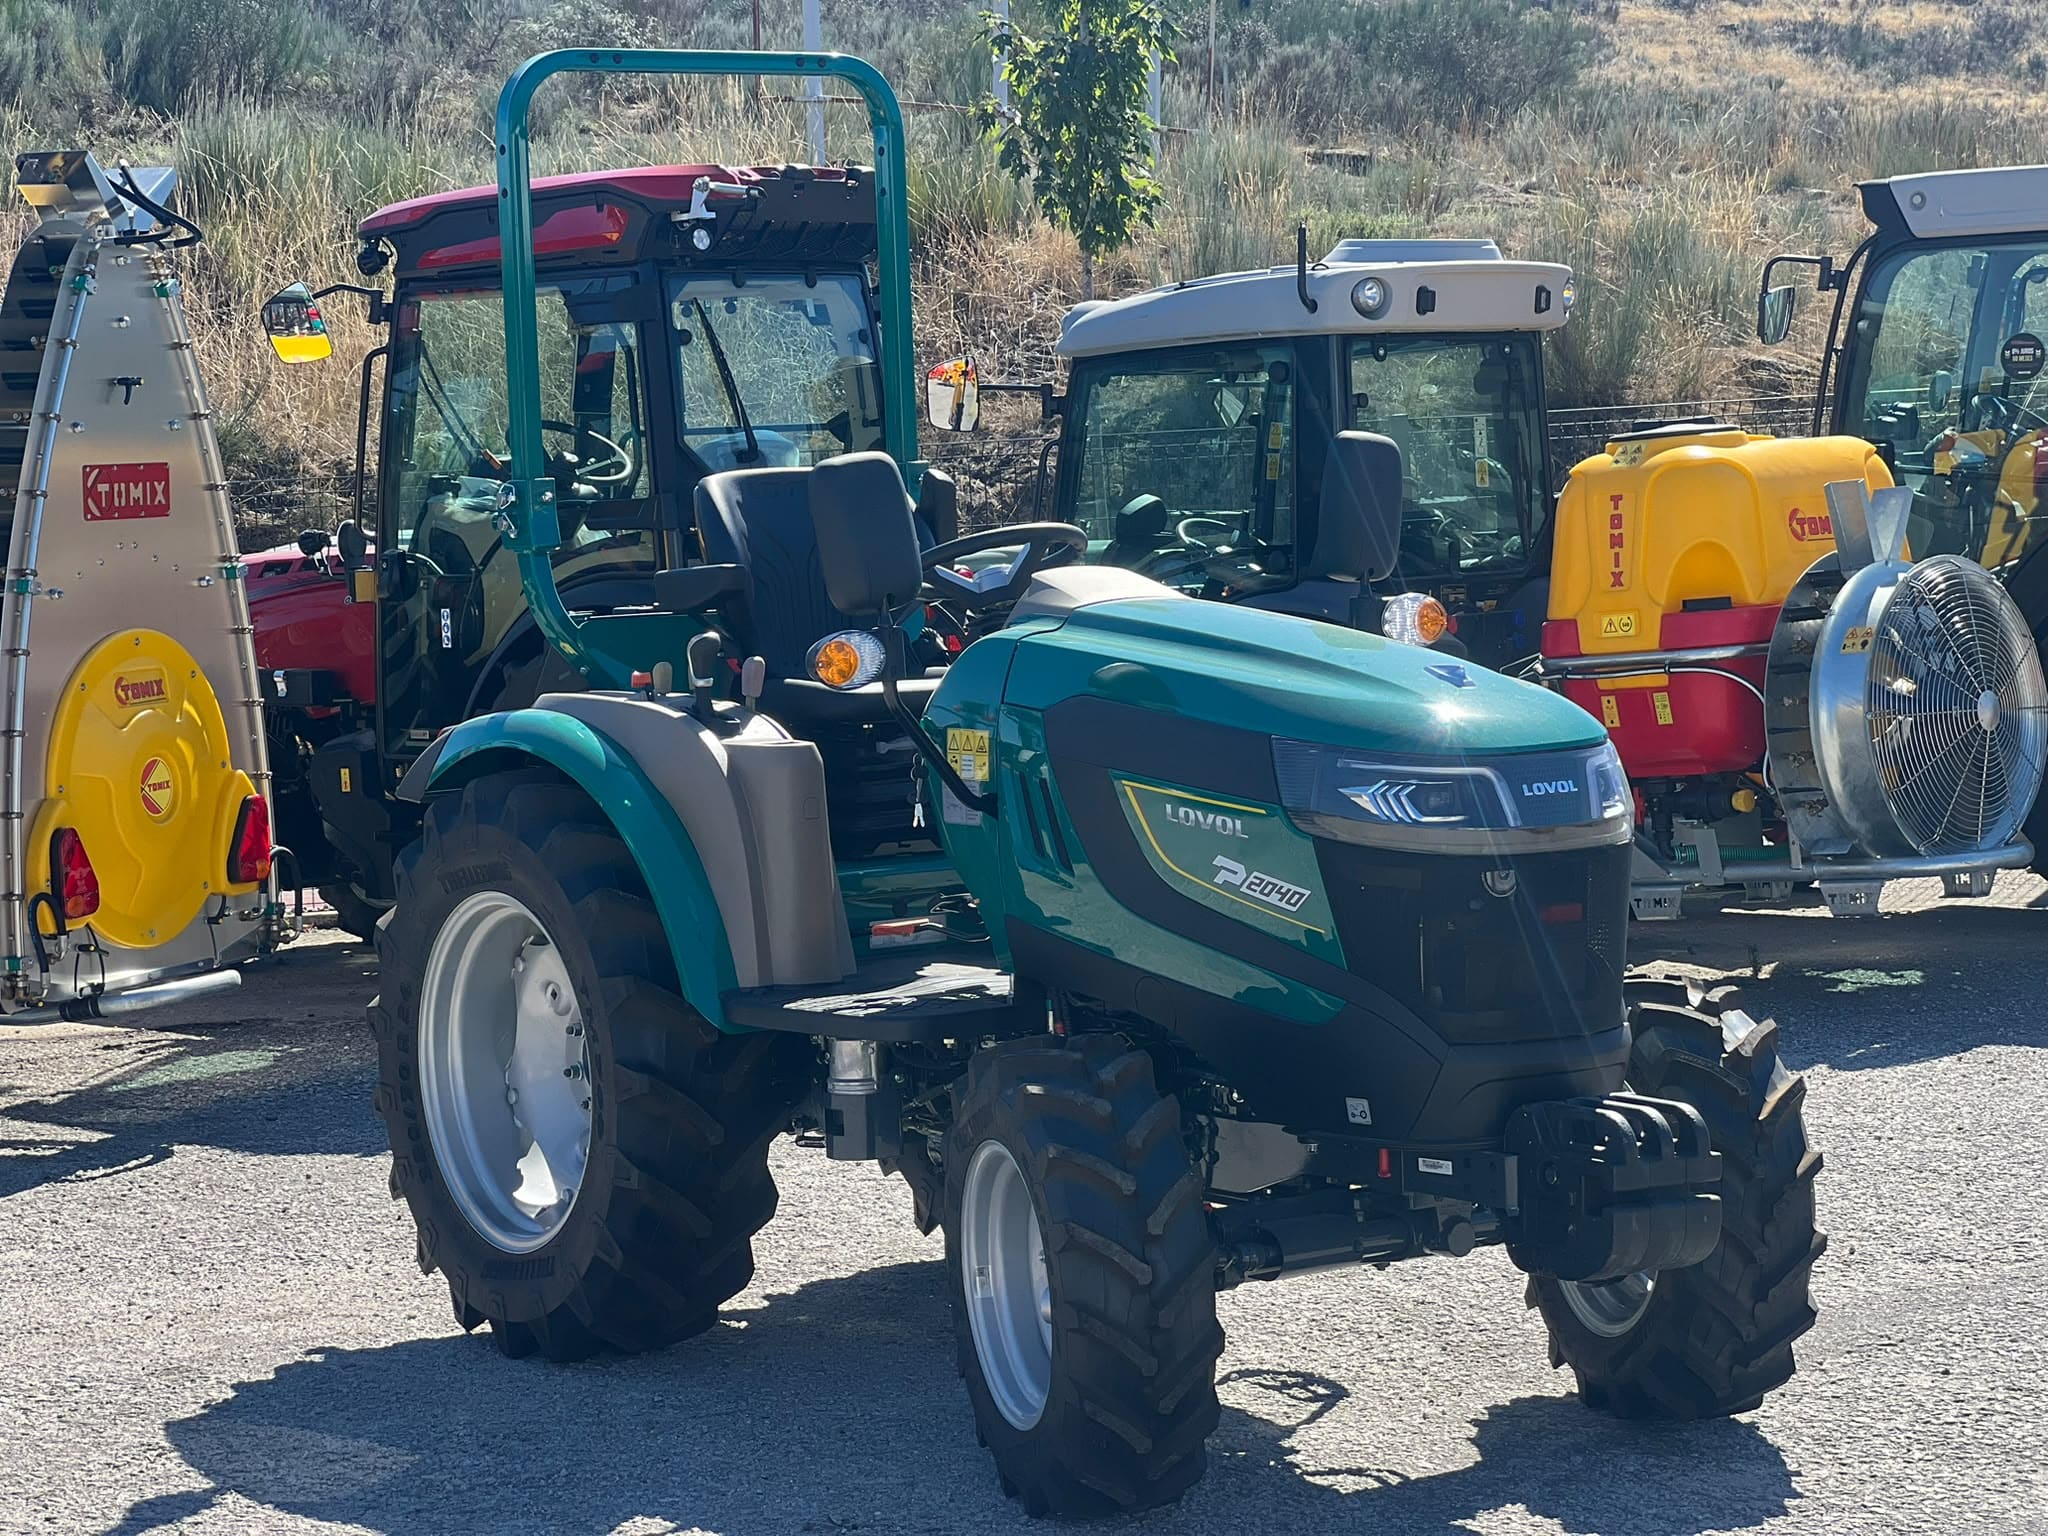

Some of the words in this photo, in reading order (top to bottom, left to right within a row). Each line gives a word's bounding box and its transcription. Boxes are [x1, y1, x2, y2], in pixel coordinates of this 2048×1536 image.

[97, 481, 166, 508] TOMIX
[1796, 515, 1832, 537] TOM
[1609, 494, 1624, 588] TOMIX
[120, 678, 165, 701] TOMIX
[147, 780, 171, 792] TOMIX
[1522, 780, 1579, 796] LOVOL
[1165, 803, 1249, 839] LOVOL
